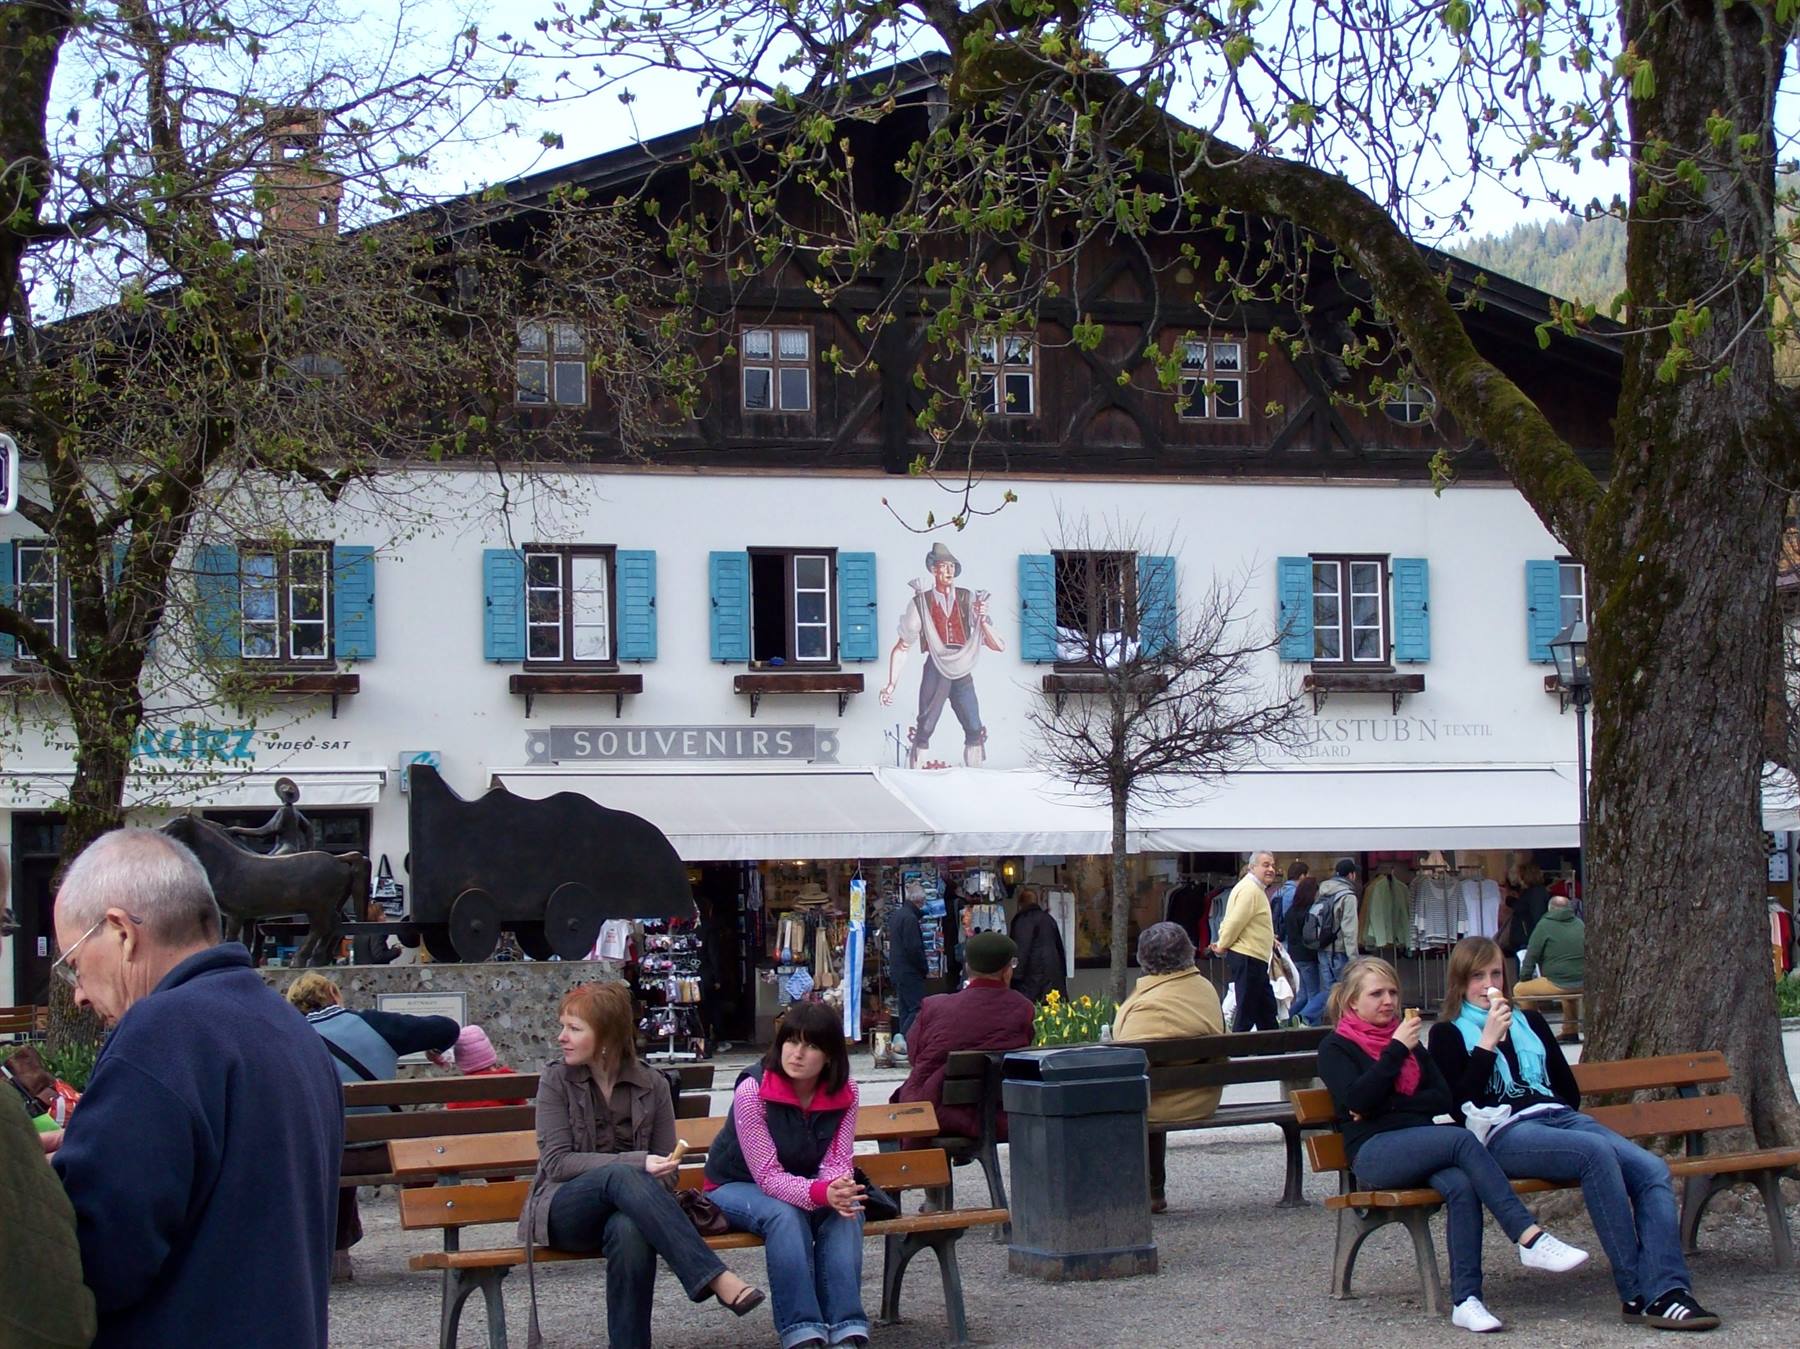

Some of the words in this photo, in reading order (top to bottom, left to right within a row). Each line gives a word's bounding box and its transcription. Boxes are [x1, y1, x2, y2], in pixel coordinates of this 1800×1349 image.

[1443, 723, 1493, 737] TEXTIL
[266, 741, 351, 750] VIDEO-SAT
[574, 731, 794, 756] SOUVENIRS
